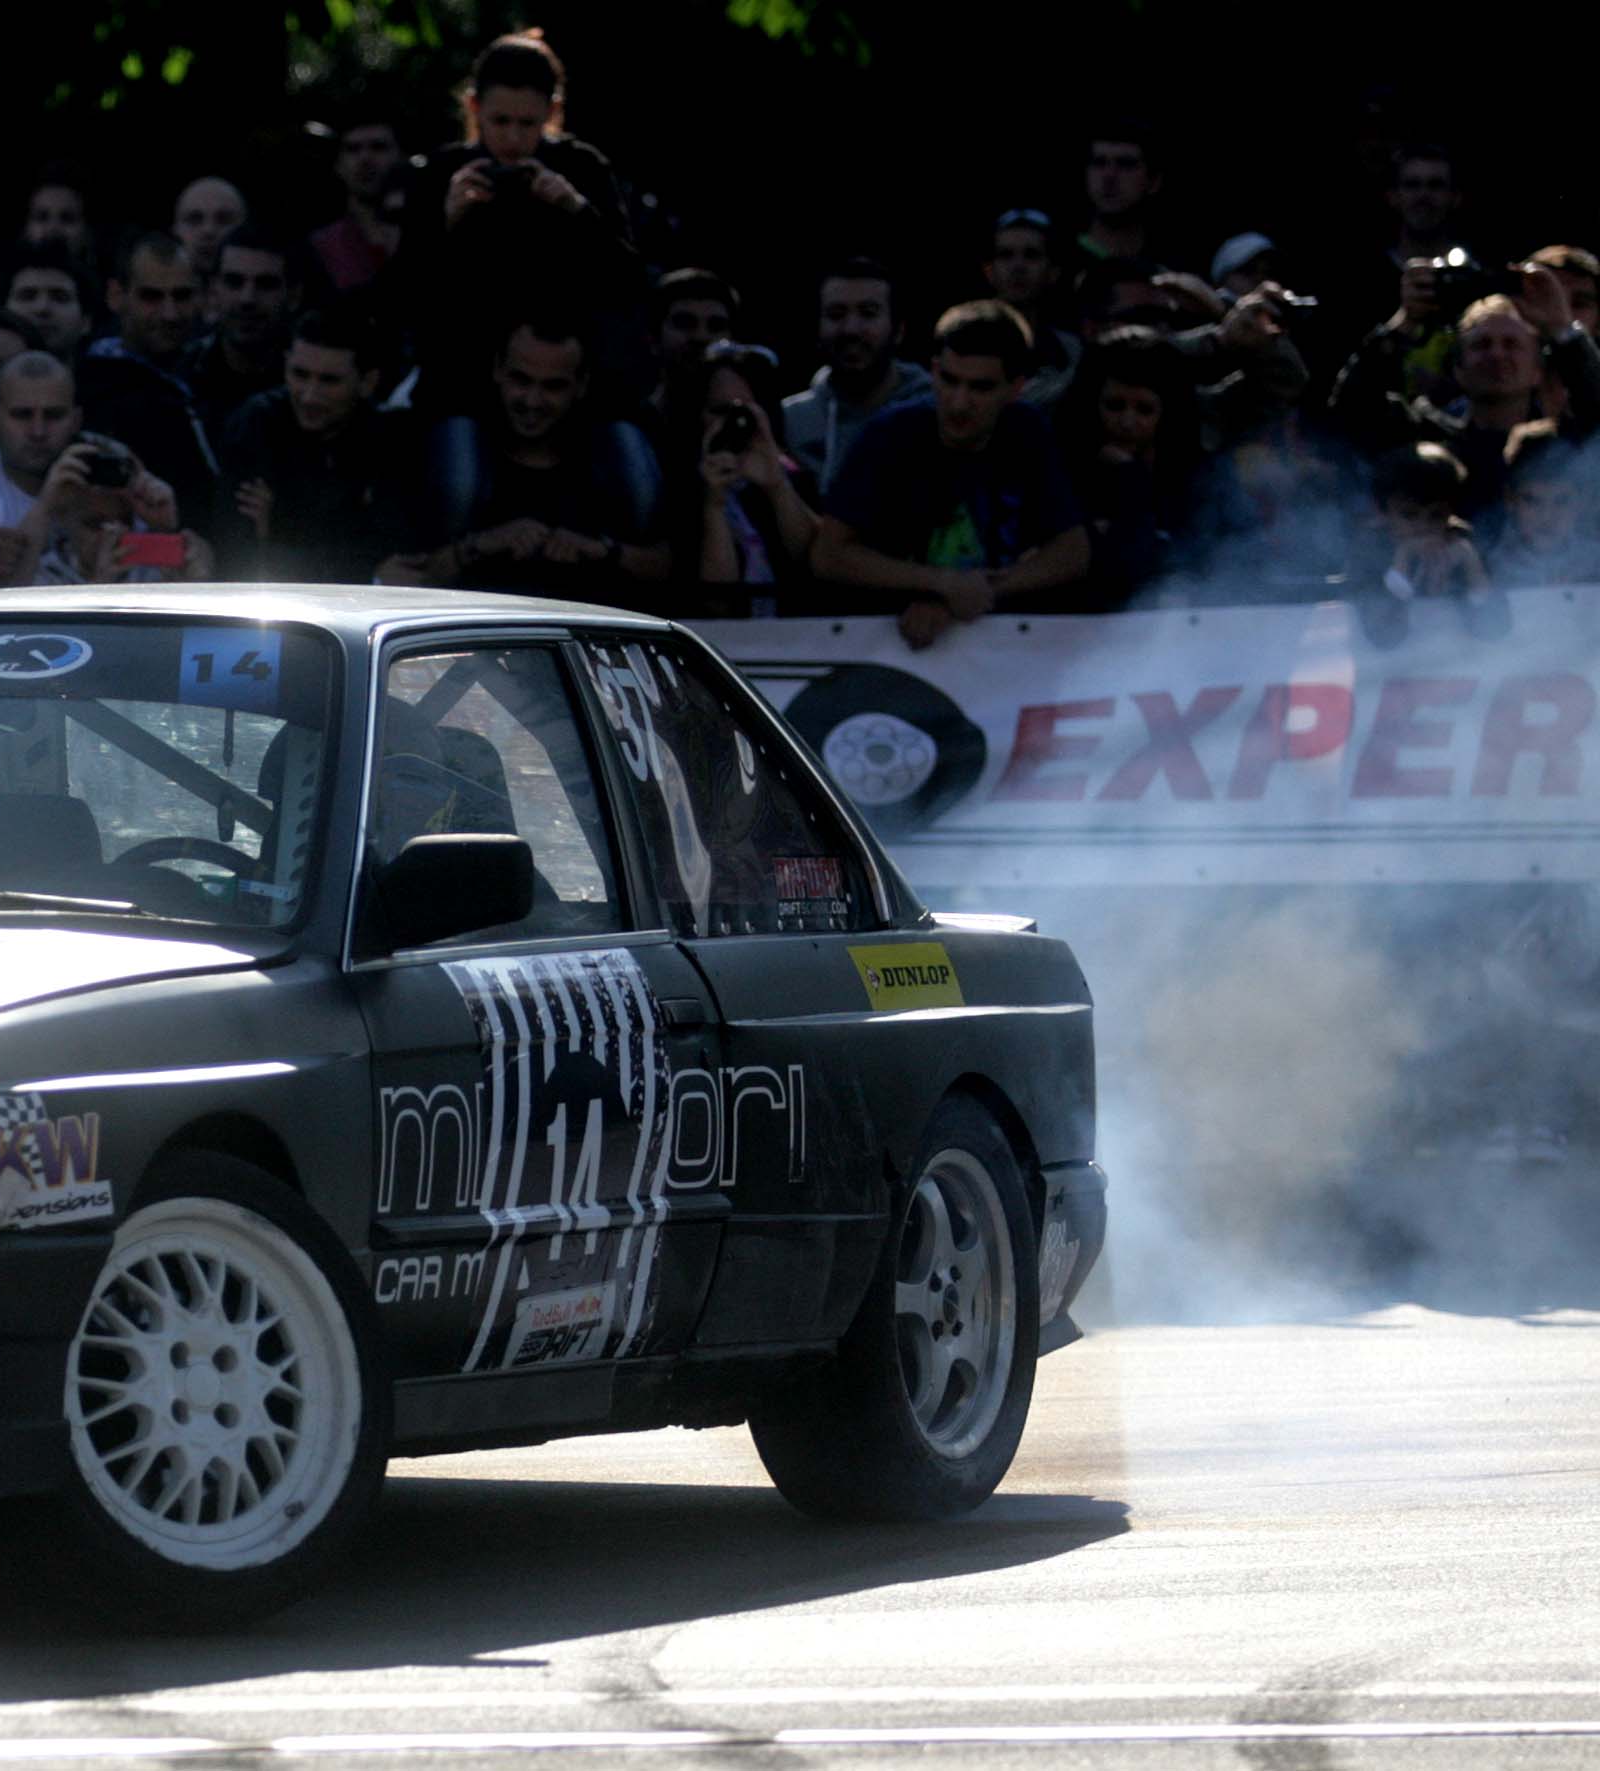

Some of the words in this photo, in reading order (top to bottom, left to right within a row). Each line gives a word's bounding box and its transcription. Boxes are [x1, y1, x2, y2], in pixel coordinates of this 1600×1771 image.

[190, 650, 273, 684] 14
[990, 670, 1598, 802] EXPER
[881, 965, 949, 988] DUNLOP
[547, 1097, 611, 1261] 14
[375, 1255, 444, 1303] CAR
